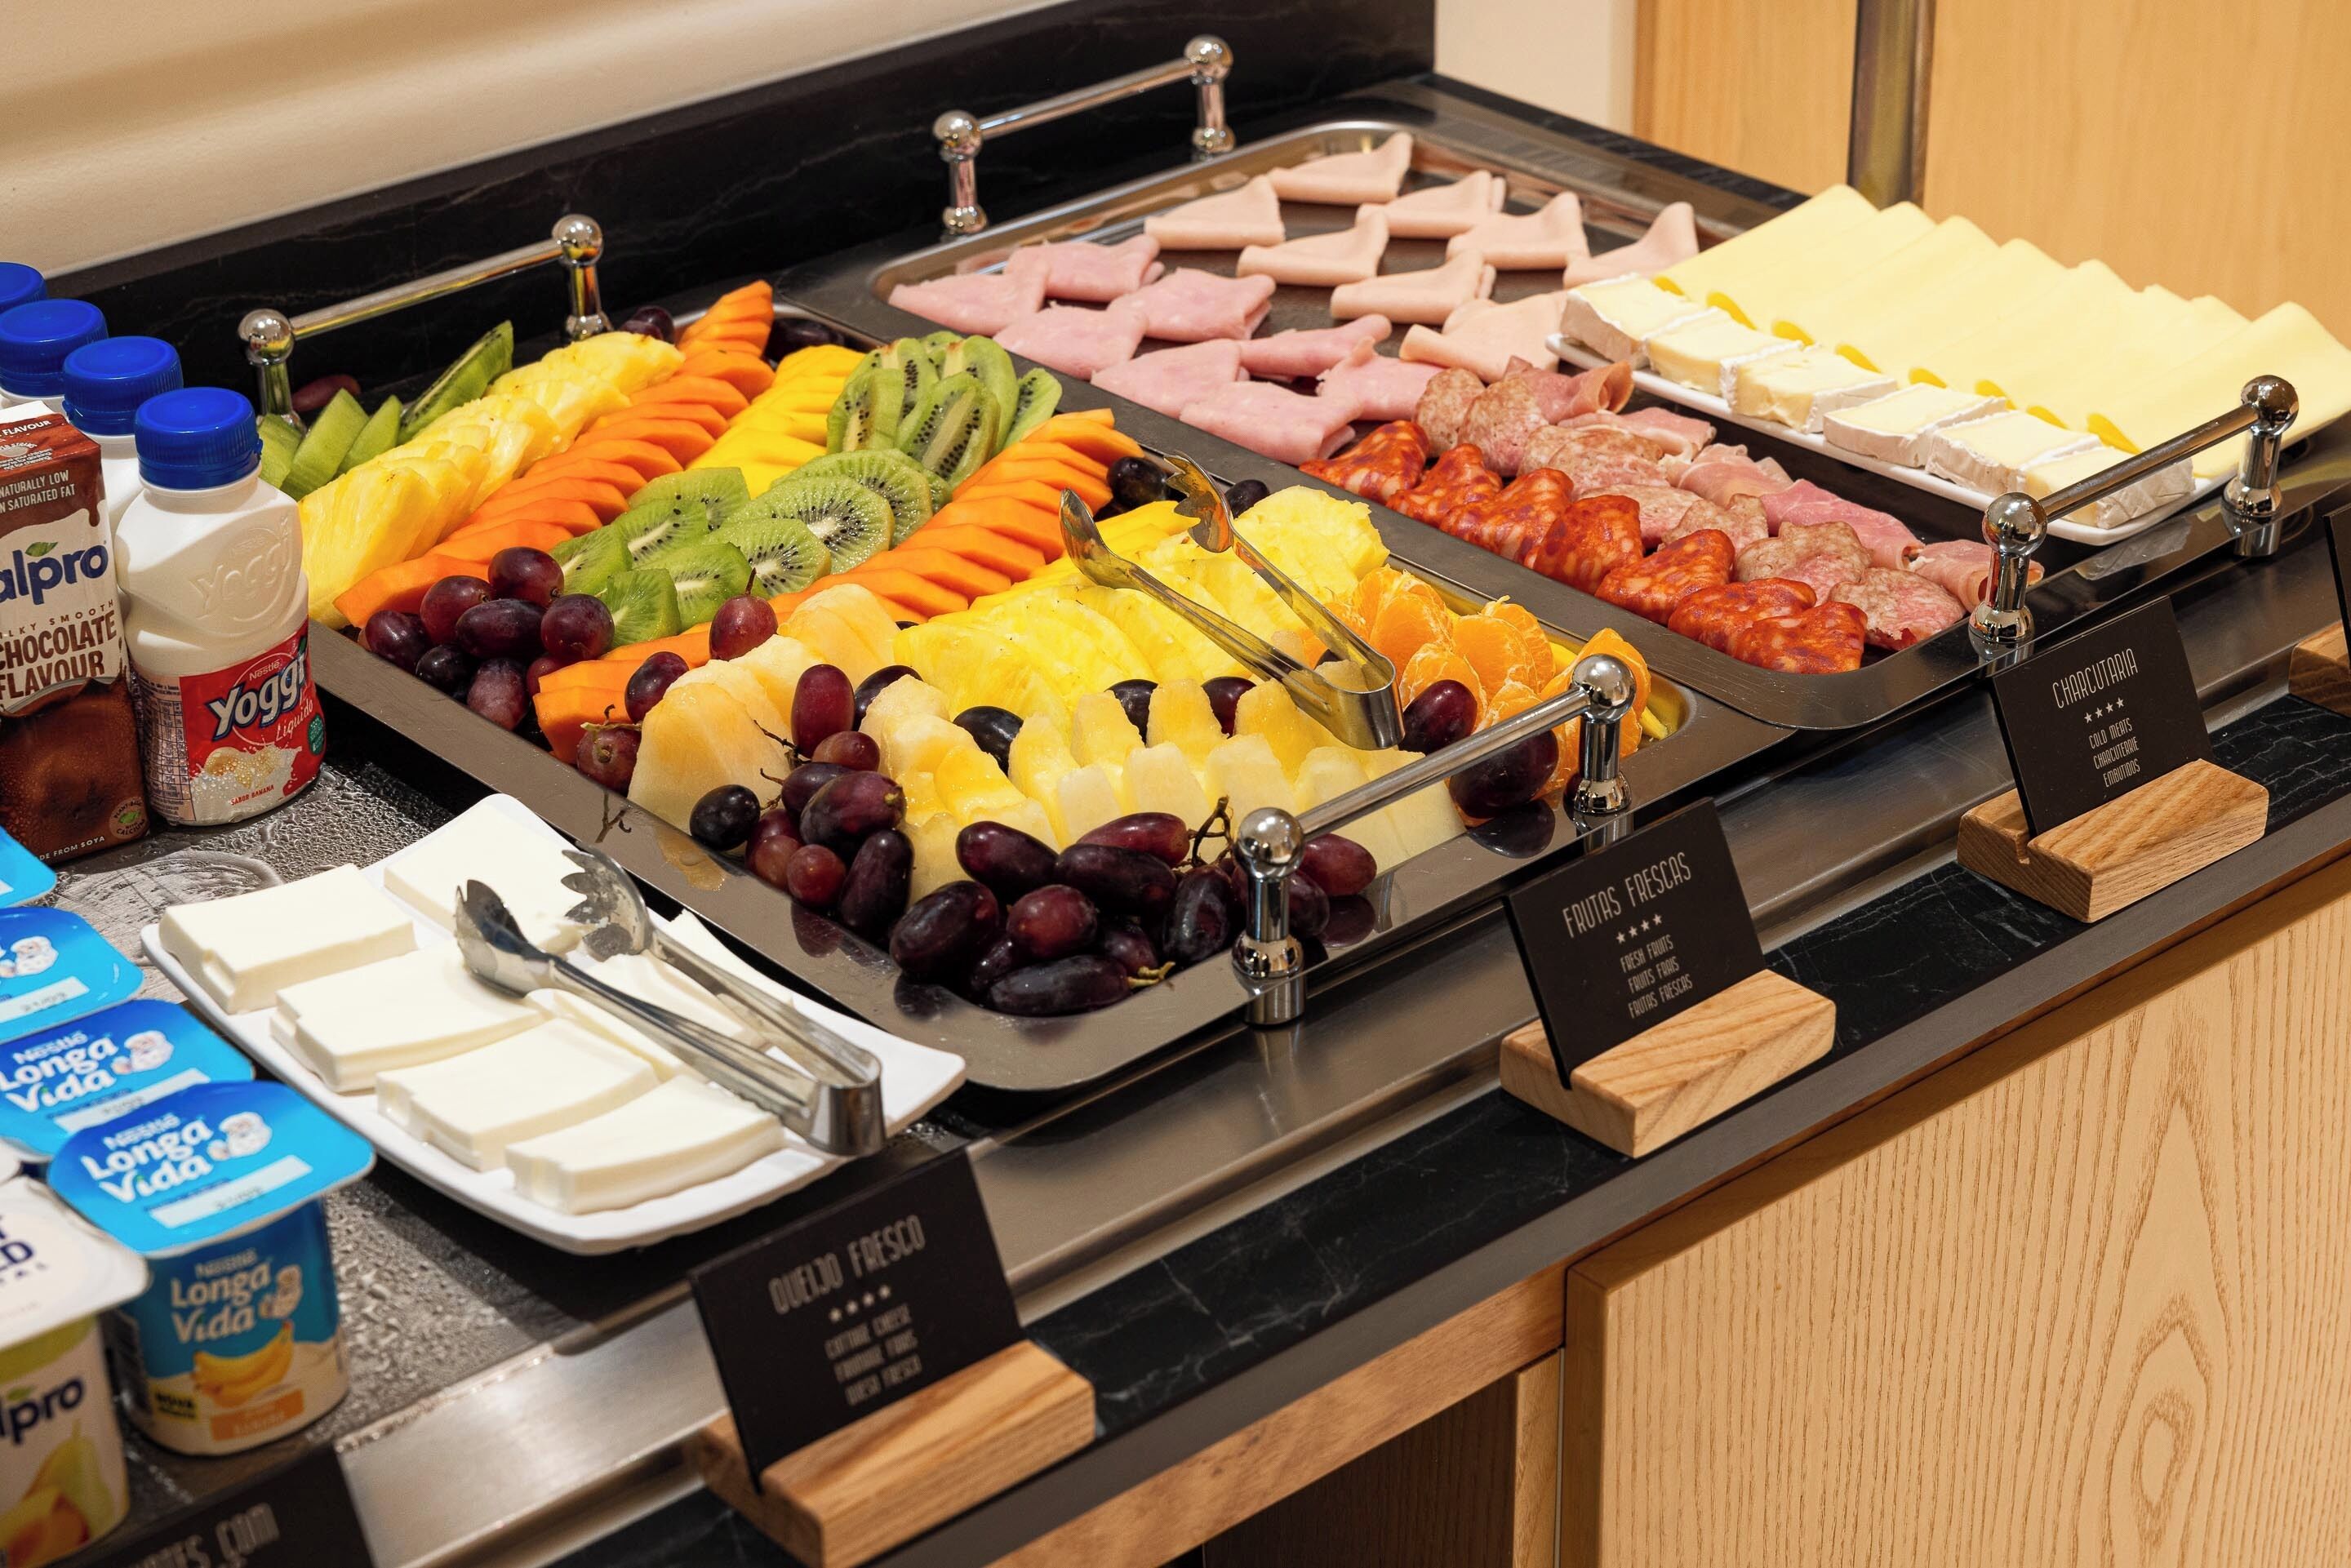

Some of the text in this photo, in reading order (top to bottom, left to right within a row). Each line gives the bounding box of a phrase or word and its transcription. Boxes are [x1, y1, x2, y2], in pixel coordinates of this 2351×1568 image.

[2, 420, 52, 436] FLAVOUR
[0, 483, 75, 513] N SATURATED FAT
[49, 469, 69, 486] LOW
[0, 544, 109, 606] alpro
[0, 598, 114, 640] ILKY SMOOTH
[206, 639, 308, 741] Yoggi
[249, 660, 282, 682] Nestlé
[2052, 648, 2138, 708] CHARCUTARIA
[2088, 717, 2133, 750] COLD MEATS
[2103, 758, 2140, 788] EMBUTIDOS
[230, 784, 274, 806] SABOR BANANA
[39, 836, 105, 860] DE FROM SOYA
[1562, 851, 1691, 939] FRUTAS FRESCAS
[1620, 934, 1673, 974] FRESH FRUITS
[1628, 956, 1680, 994] FRUITS FRAIS
[1628, 973, 1693, 1019] FRUTAS FRESCAS
[0, 1037, 119, 1092] Longa
[6, 1069, 117, 1113] Vida
[80, 1119, 214, 1180] Longa
[98, 1154, 214, 1203] Vida
[847, 1214, 926, 1279] FRESCO
[170, 1261, 271, 1308] Longa
[171, 1305, 256, 1344] Vida
